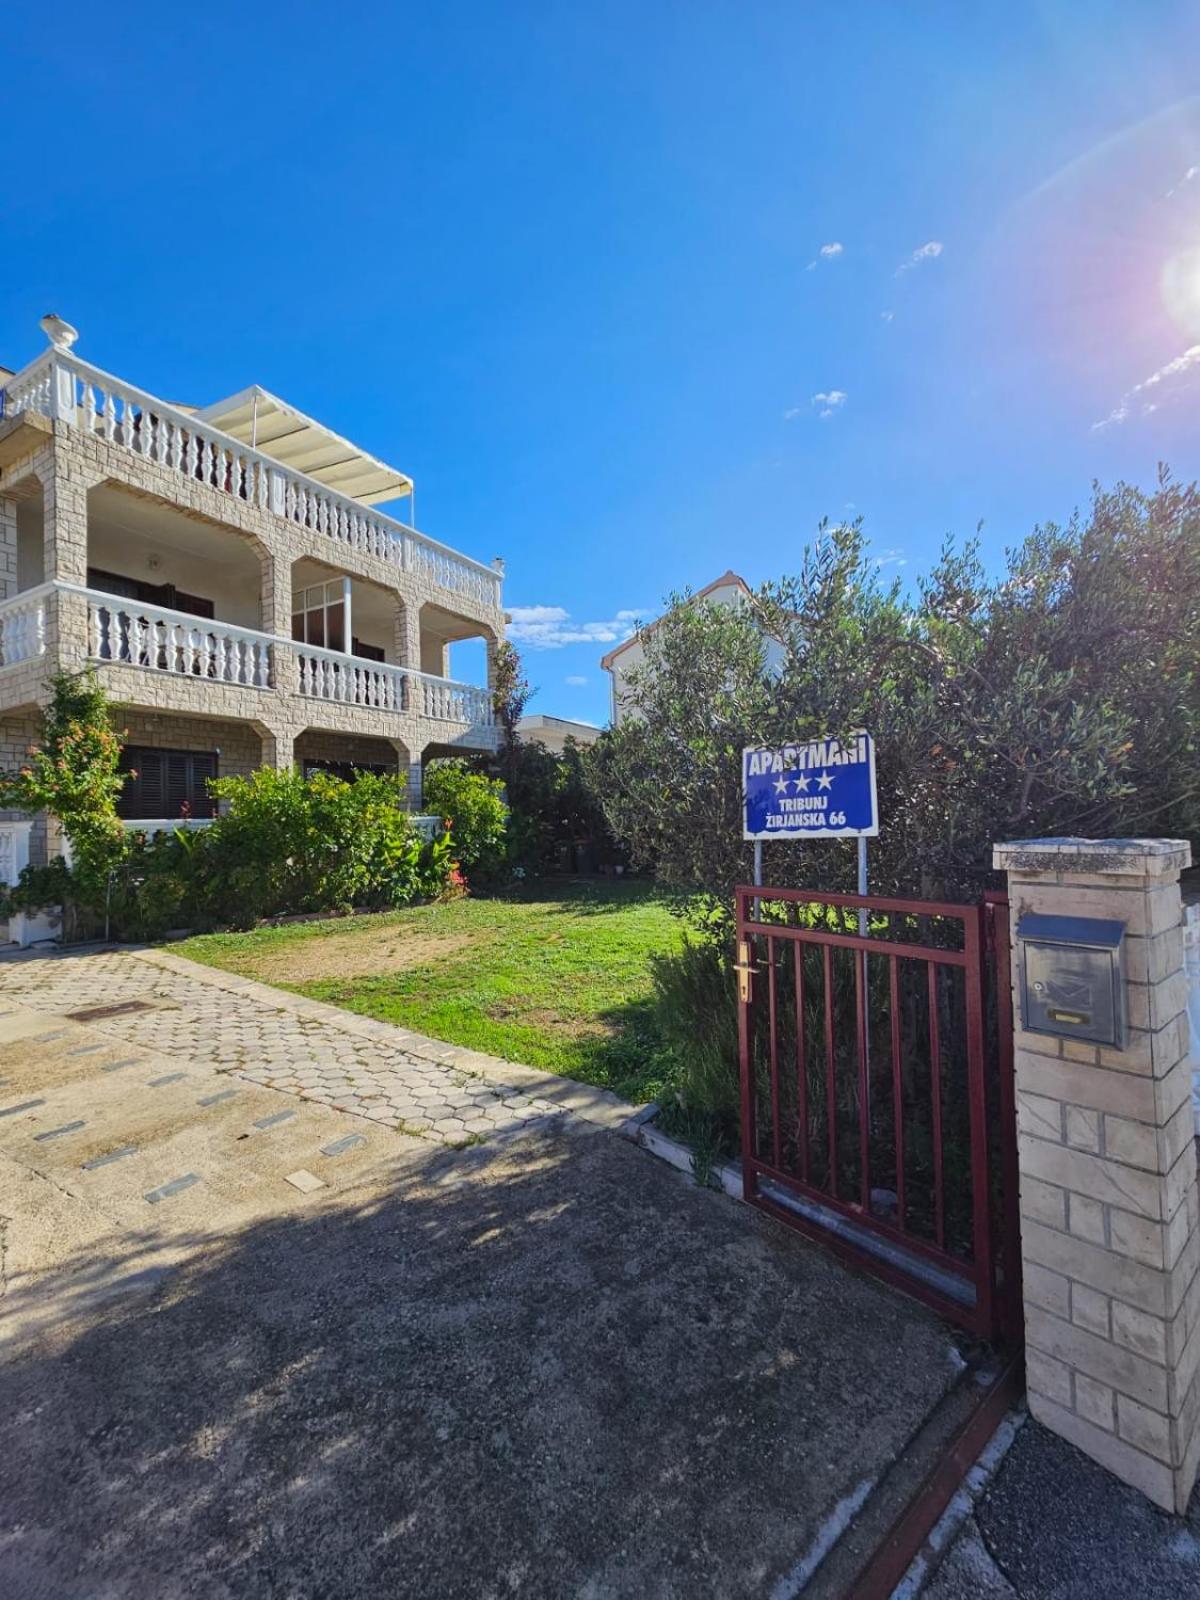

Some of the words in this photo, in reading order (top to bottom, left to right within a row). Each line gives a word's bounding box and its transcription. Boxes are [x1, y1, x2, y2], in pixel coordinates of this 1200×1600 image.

[779, 796, 828, 812] TRIBUNJ
[765, 812, 826, 828] ŽIRJANSKA
[829, 811, 847, 825] 66
